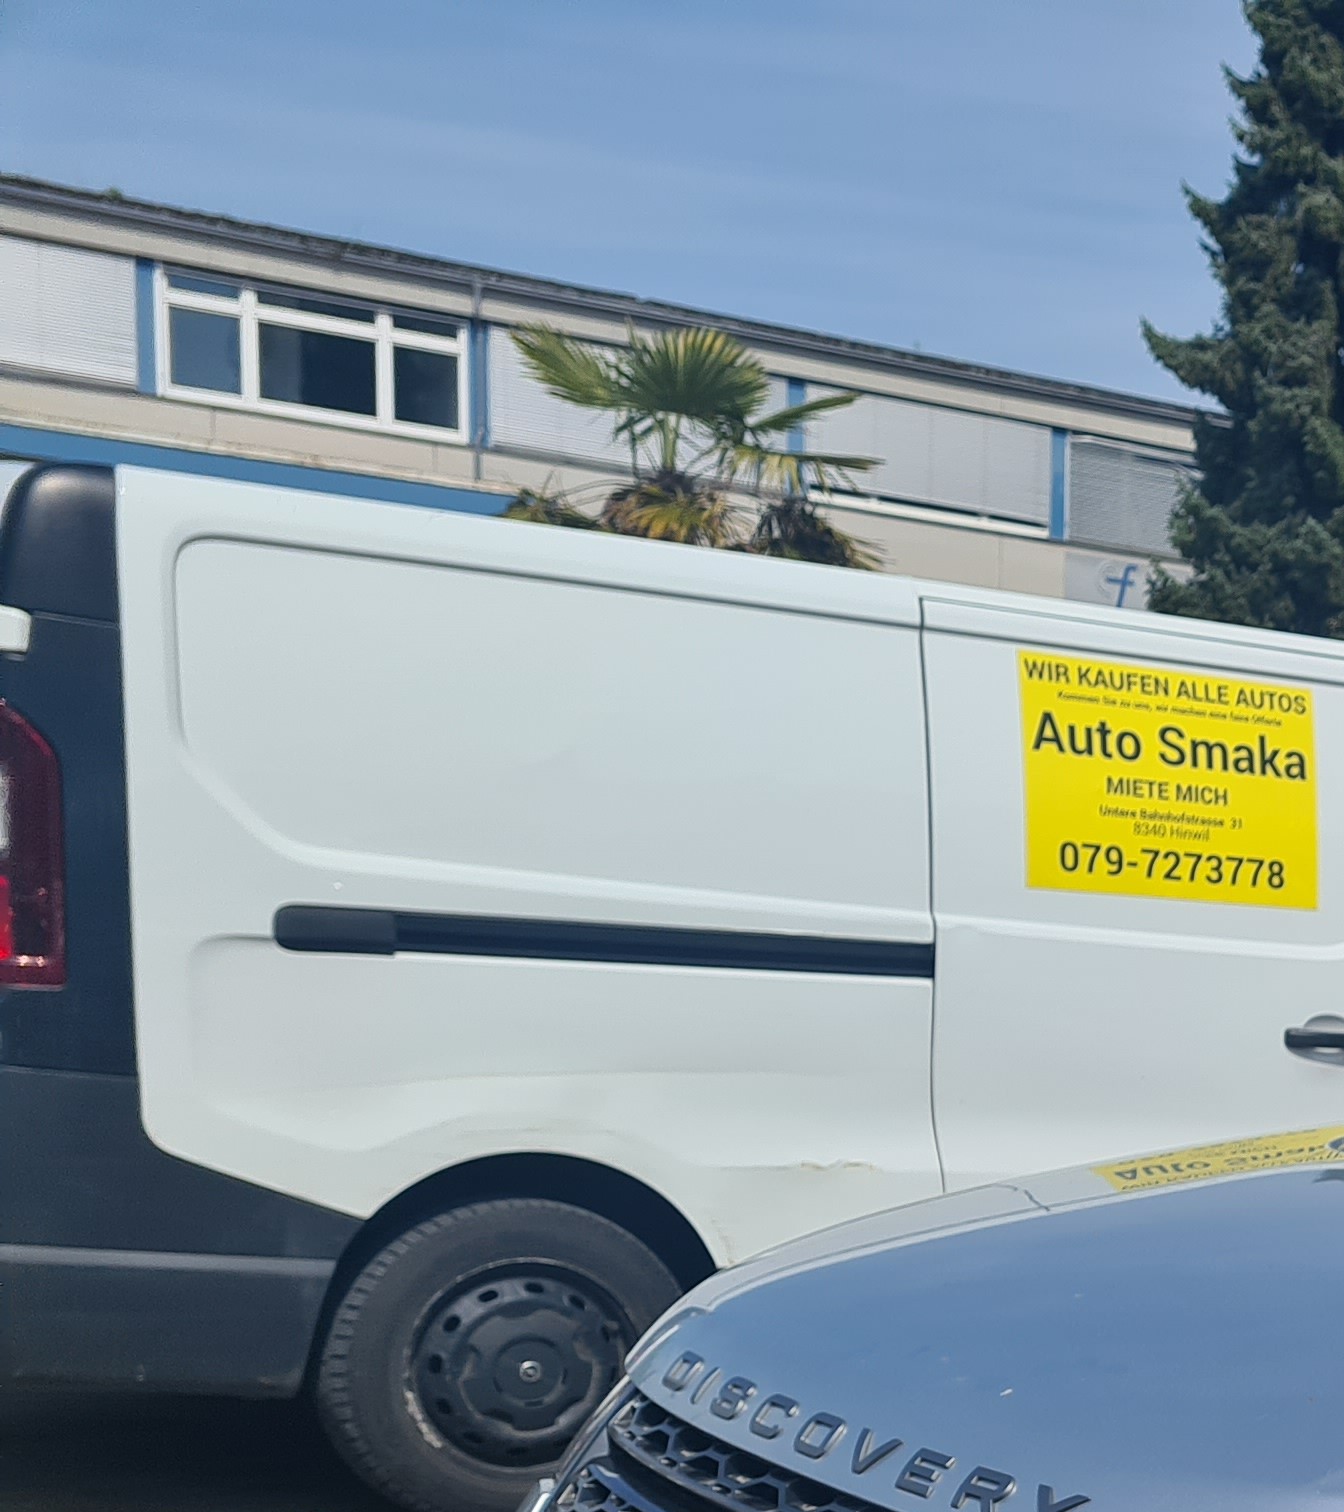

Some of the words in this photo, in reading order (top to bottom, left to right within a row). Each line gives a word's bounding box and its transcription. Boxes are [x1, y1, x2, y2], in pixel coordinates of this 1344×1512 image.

[1023, 657, 1070, 684] WIR
[1077, 665, 1170, 698] KAUFEN
[1176, 679, 1230, 706] ALLE
[1235, 687, 1308, 715] AUTOS
[1032, 710, 1142, 761] Auto
[1158, 725, 1307, 781] Smaka
[1106, 776, 1170, 801] MIETE
[1175, 783, 1229, 807] MICH
[1133, 821, 1167, 839] 8340
[1169, 824, 1210, 842] Hinwil
[1059, 841, 1286, 889] 079-7273778
